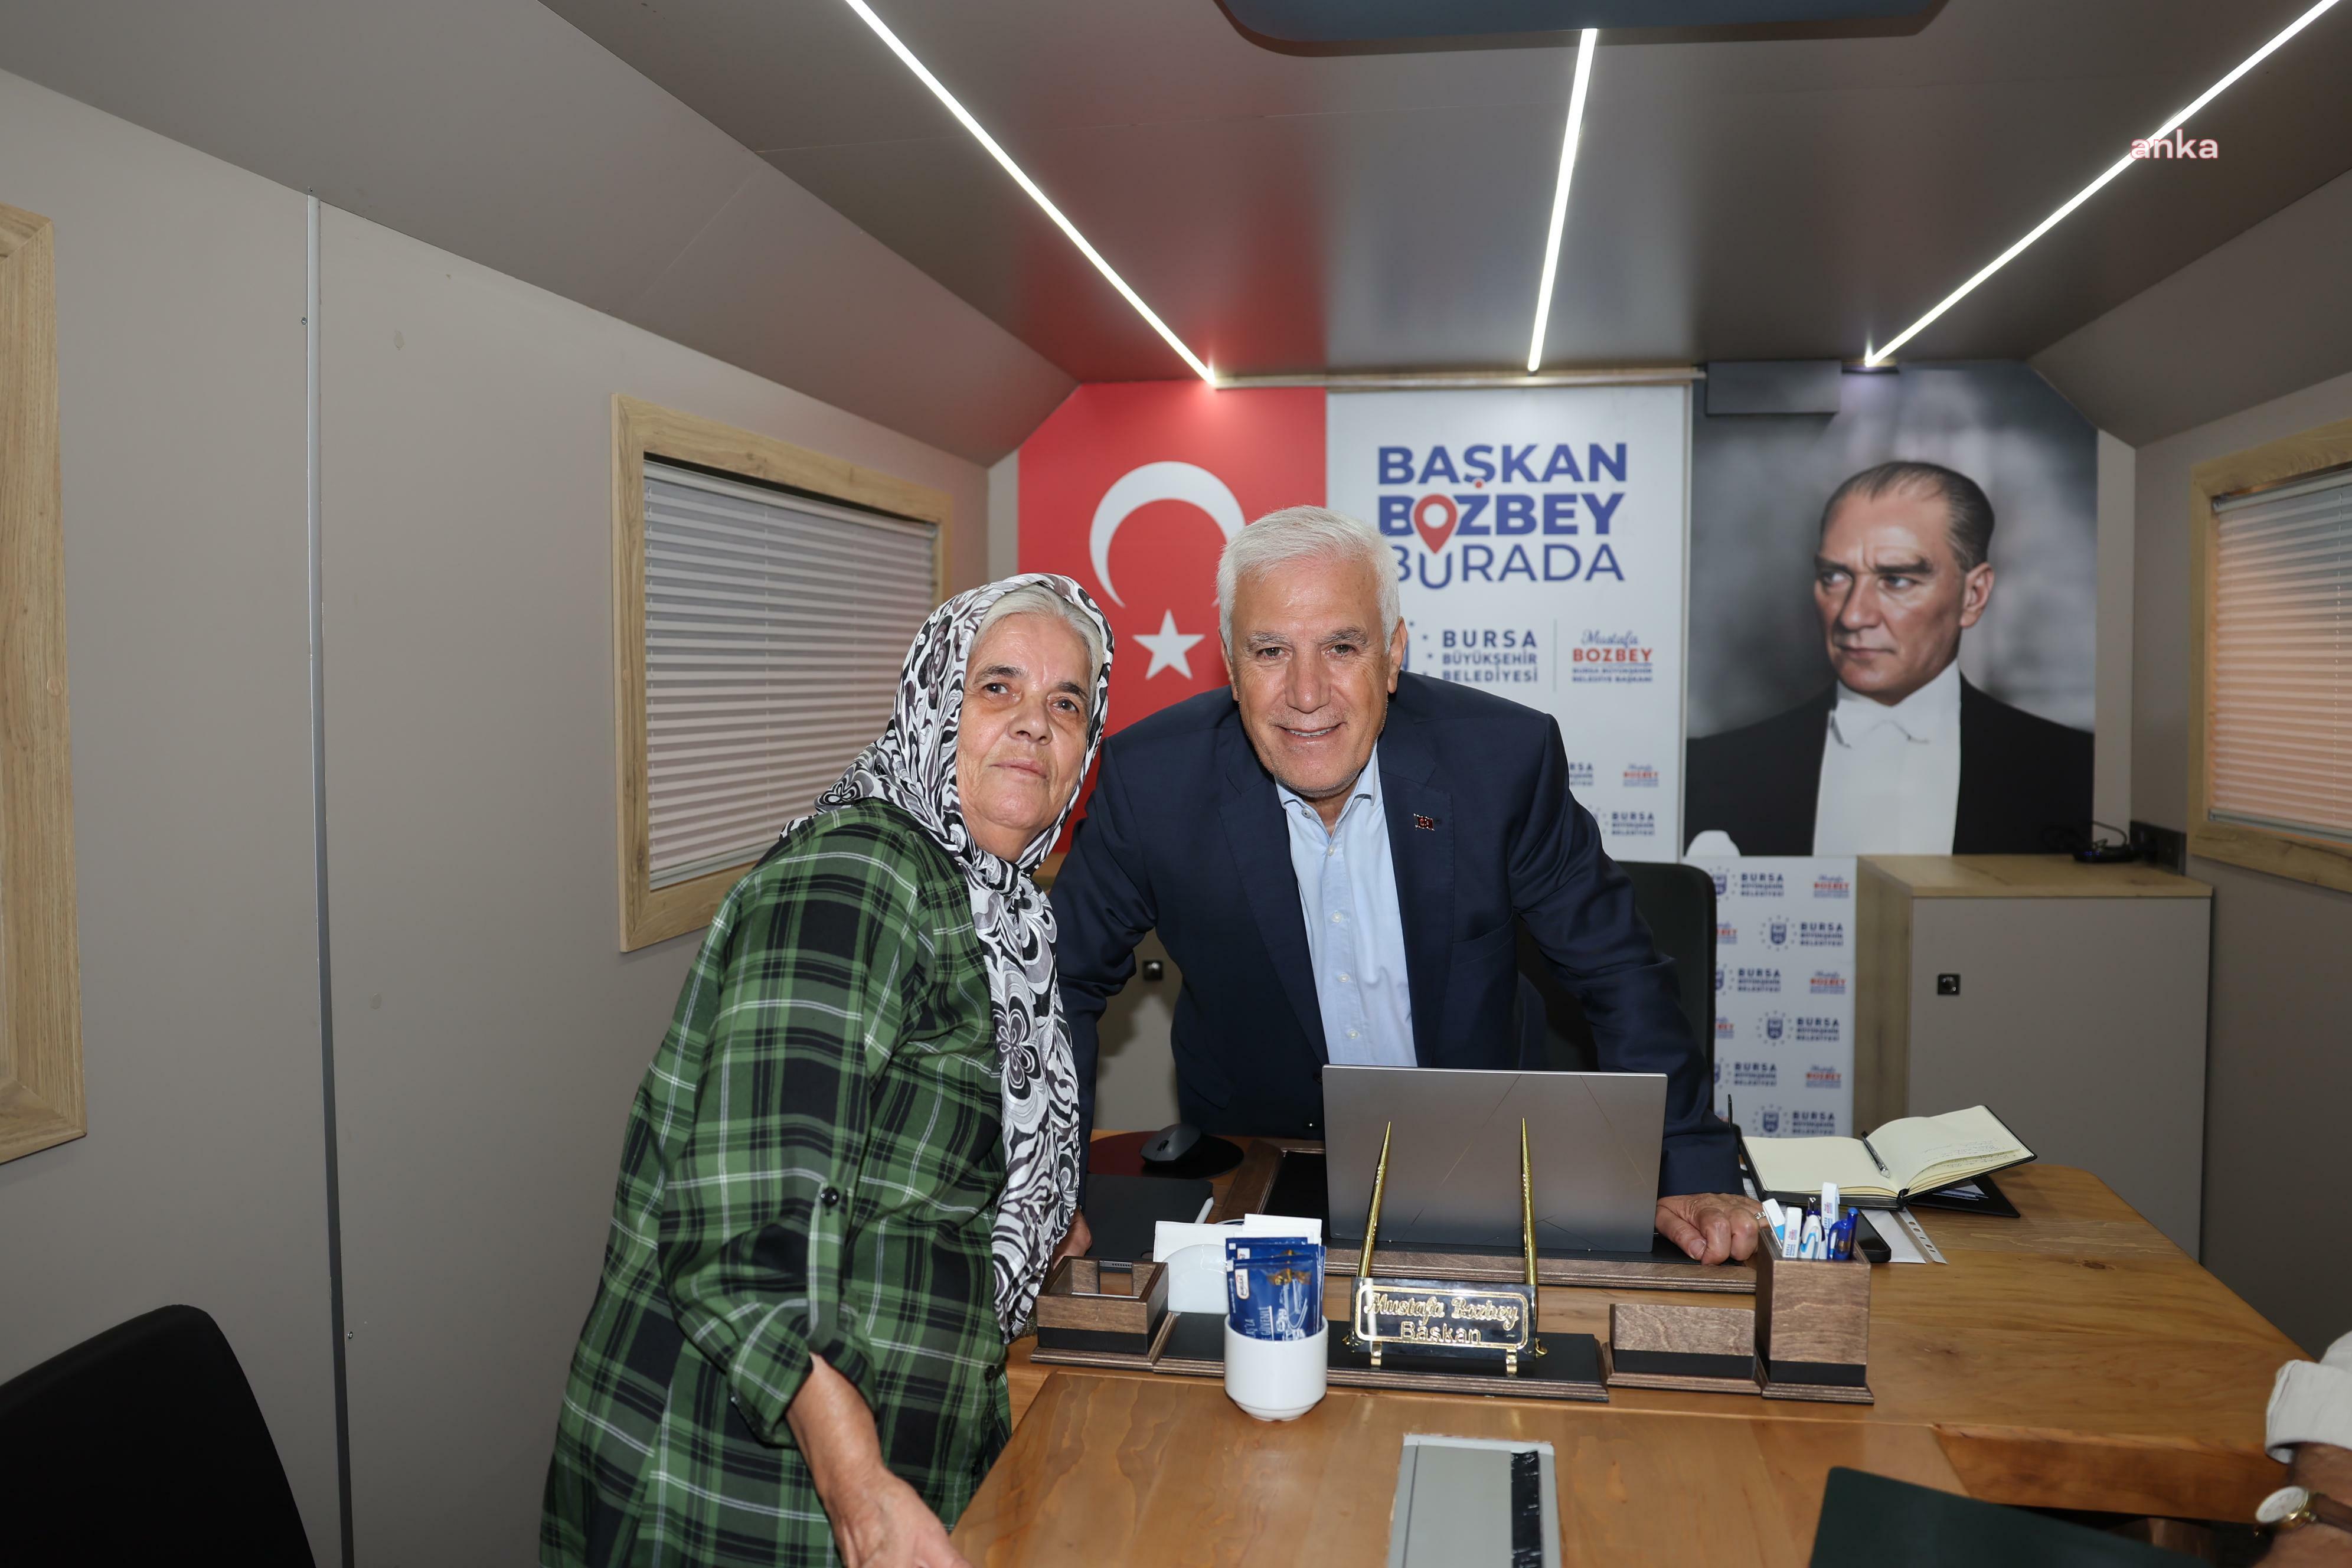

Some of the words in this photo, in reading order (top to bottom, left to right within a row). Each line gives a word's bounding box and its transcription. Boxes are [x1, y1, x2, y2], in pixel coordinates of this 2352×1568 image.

[1378, 443, 1627, 489] BAŞKAN
[1443, 630, 1537, 648] BURSA
[1443, 649, 1537, 668] BÜYÜKŞEHİR
[1572, 648, 1653, 662] BOZBEY
[1443, 667, 1538, 682] BELEDİYESİ
[1364, 1293, 1445, 1325] Mustafa
[1451, 1296, 1520, 1331] Bozbey
